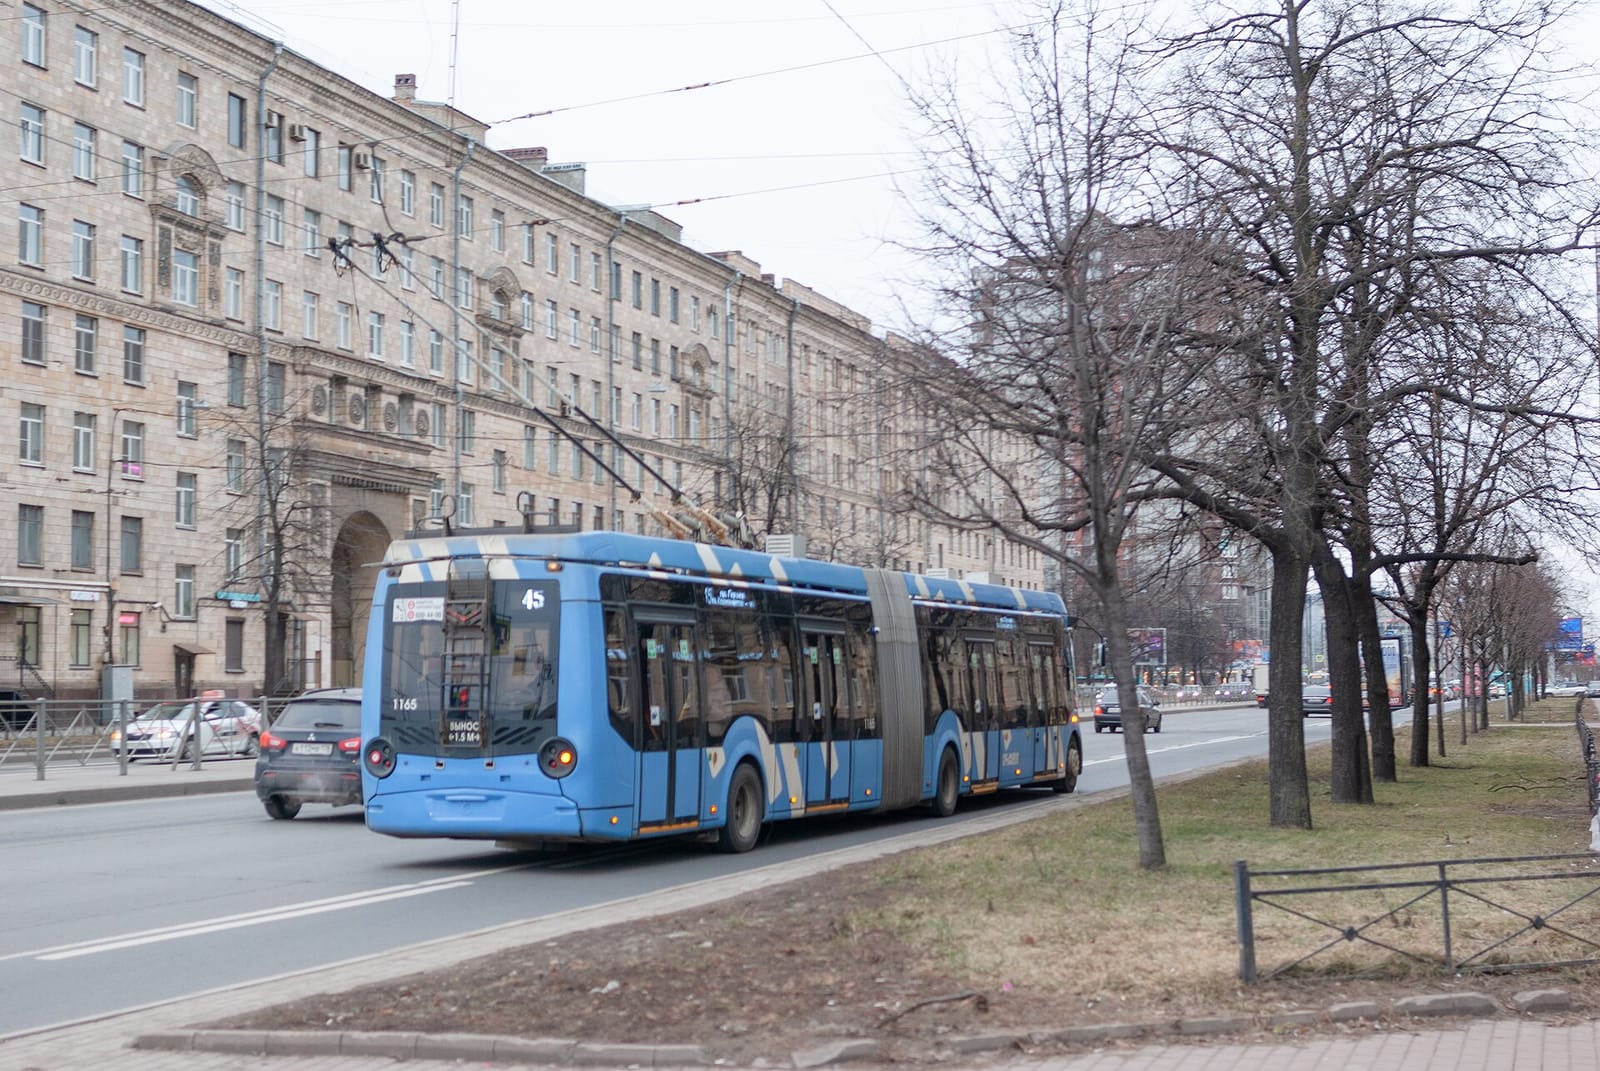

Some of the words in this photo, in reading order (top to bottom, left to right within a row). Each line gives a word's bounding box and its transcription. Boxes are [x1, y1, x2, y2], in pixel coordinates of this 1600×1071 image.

[521, 588, 545, 610] 45
[393, 698, 417, 711] 1165
[449, 721, 480, 731] ВЫНОС
